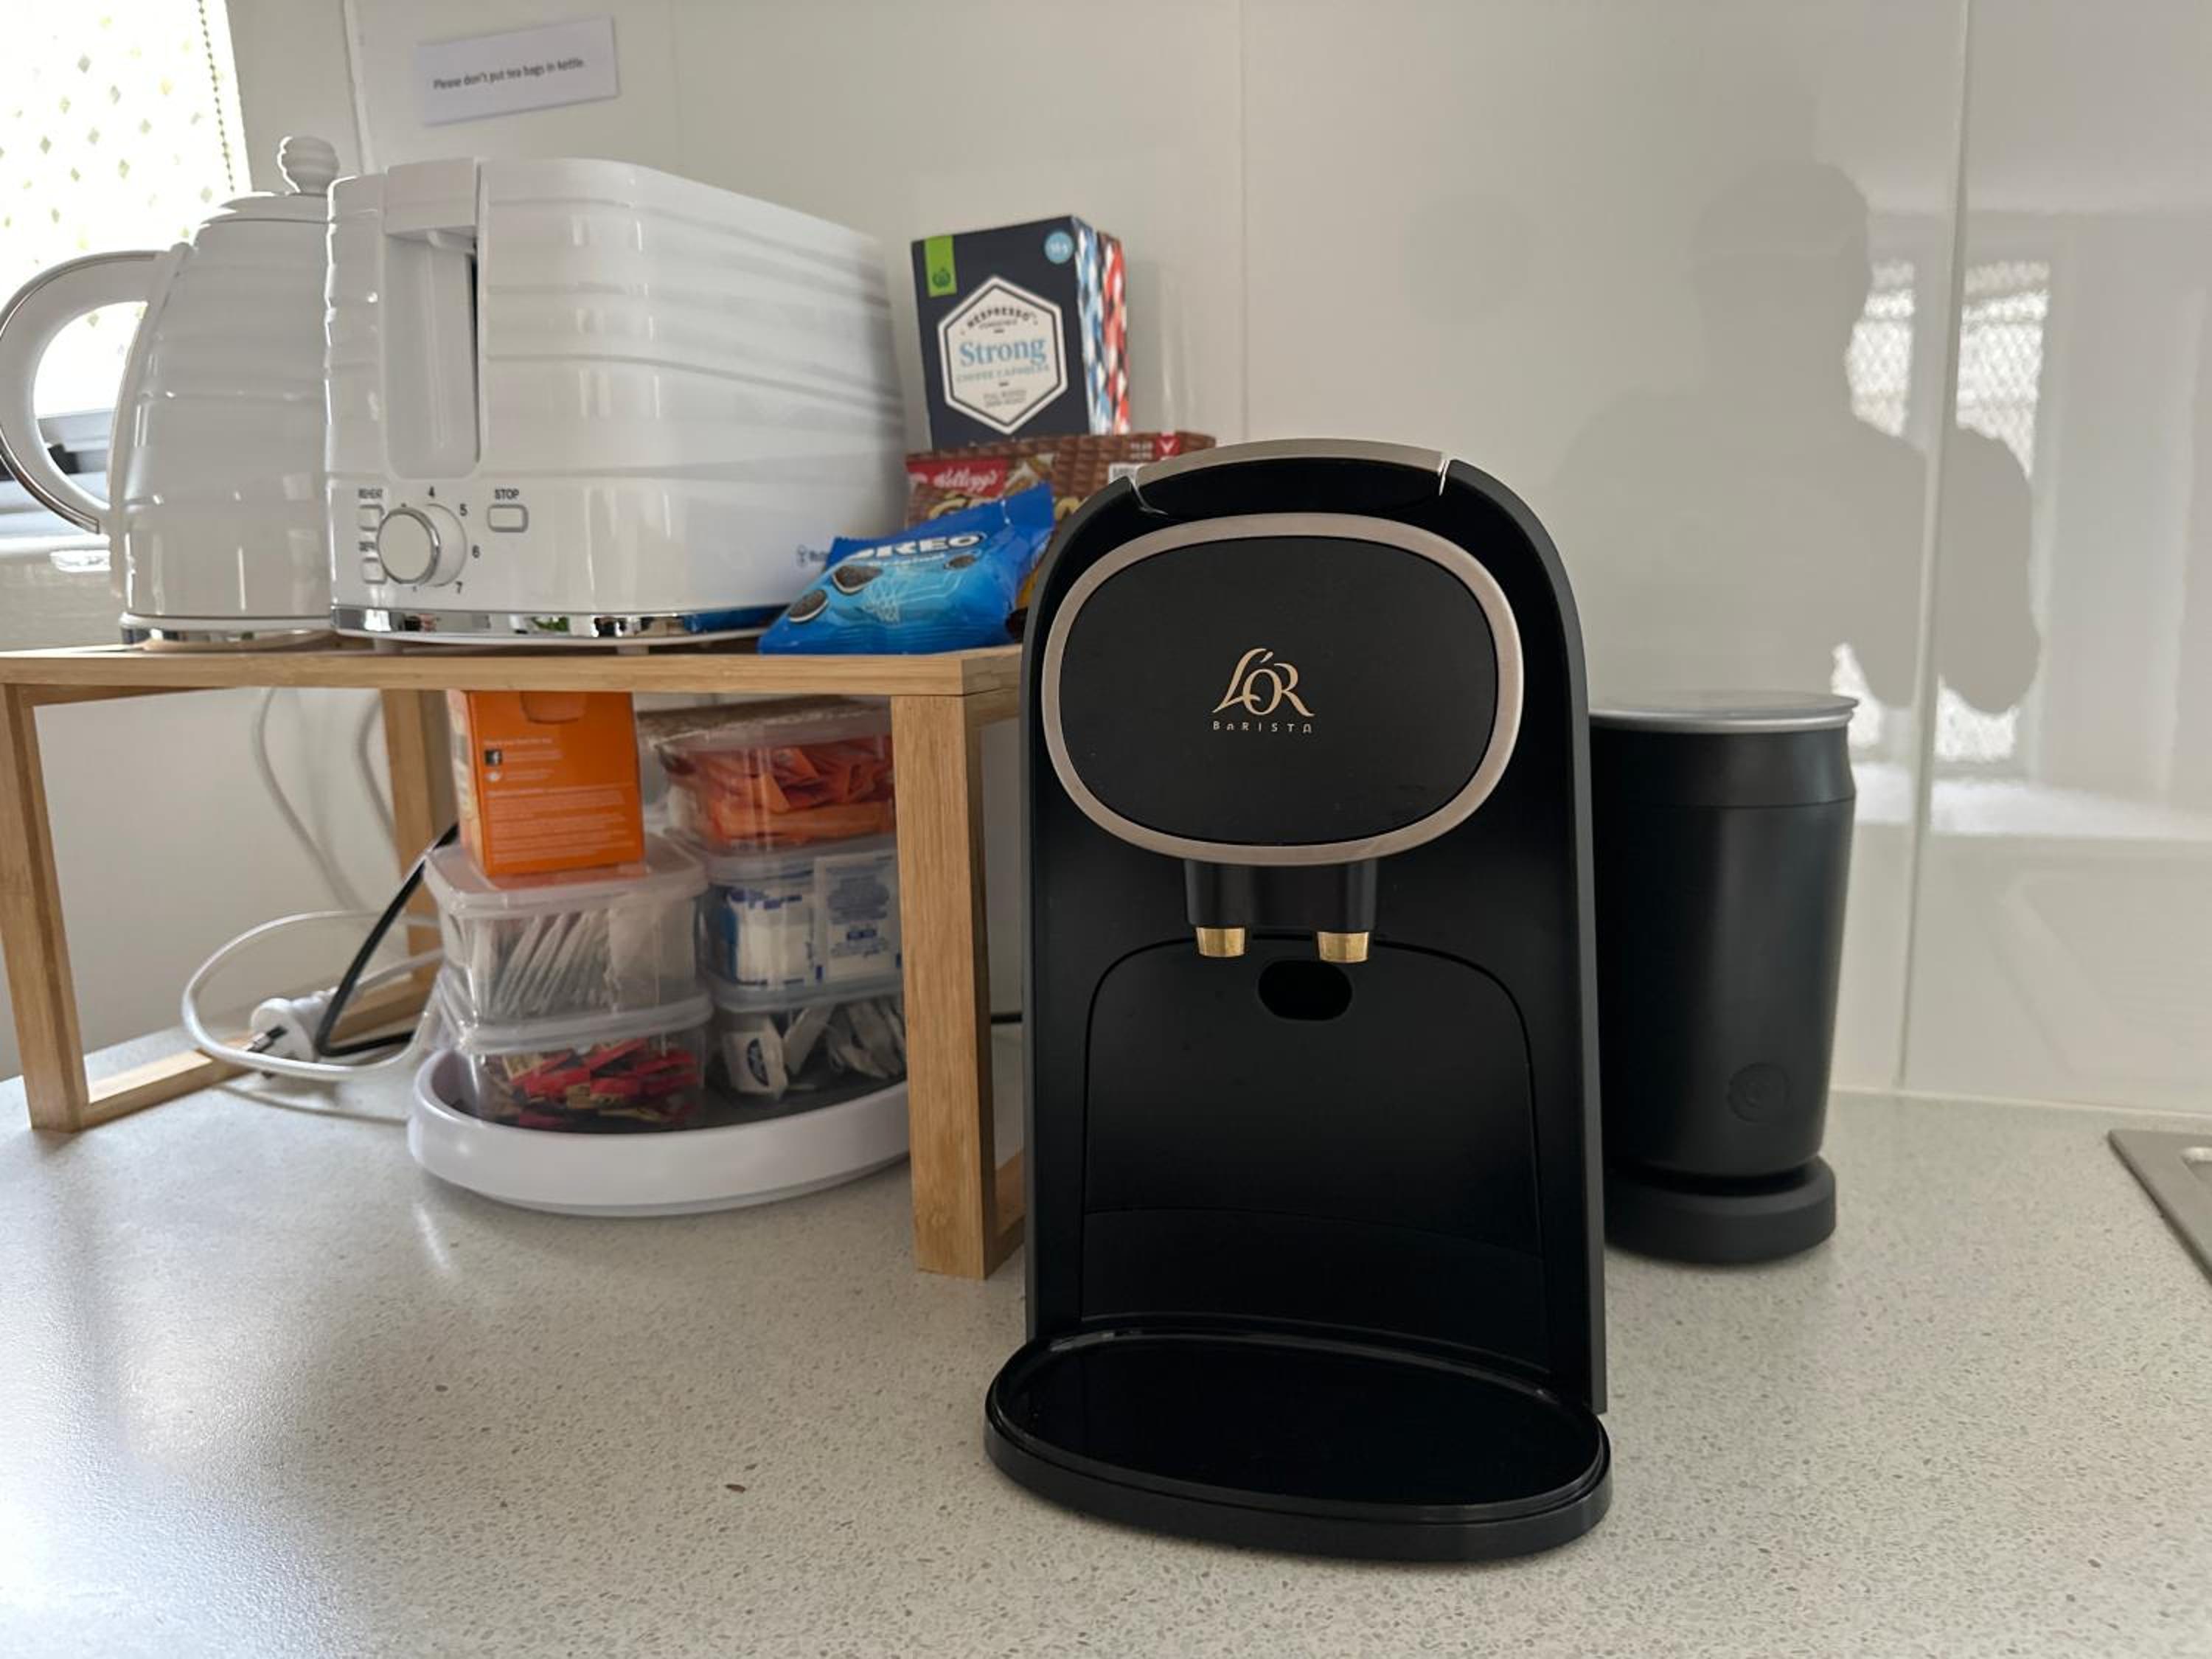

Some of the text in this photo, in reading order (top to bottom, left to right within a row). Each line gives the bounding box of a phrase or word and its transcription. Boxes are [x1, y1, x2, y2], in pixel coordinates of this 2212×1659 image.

[433, 78, 462, 89] Please
[463, 72, 487, 86] don't
[490, 70, 504, 84] put
[523, 65, 544, 77] bags
[546, 63, 555, 72] in
[959, 338, 1047, 367] Strong
[428, 486, 435, 498] 4
[494, 488, 520, 500] STOP
[459, 503, 468, 517] 5
[472, 545, 481, 559] 6
[456, 581, 464, 594] 7
[1213, 720, 1312, 733] BARISTA
